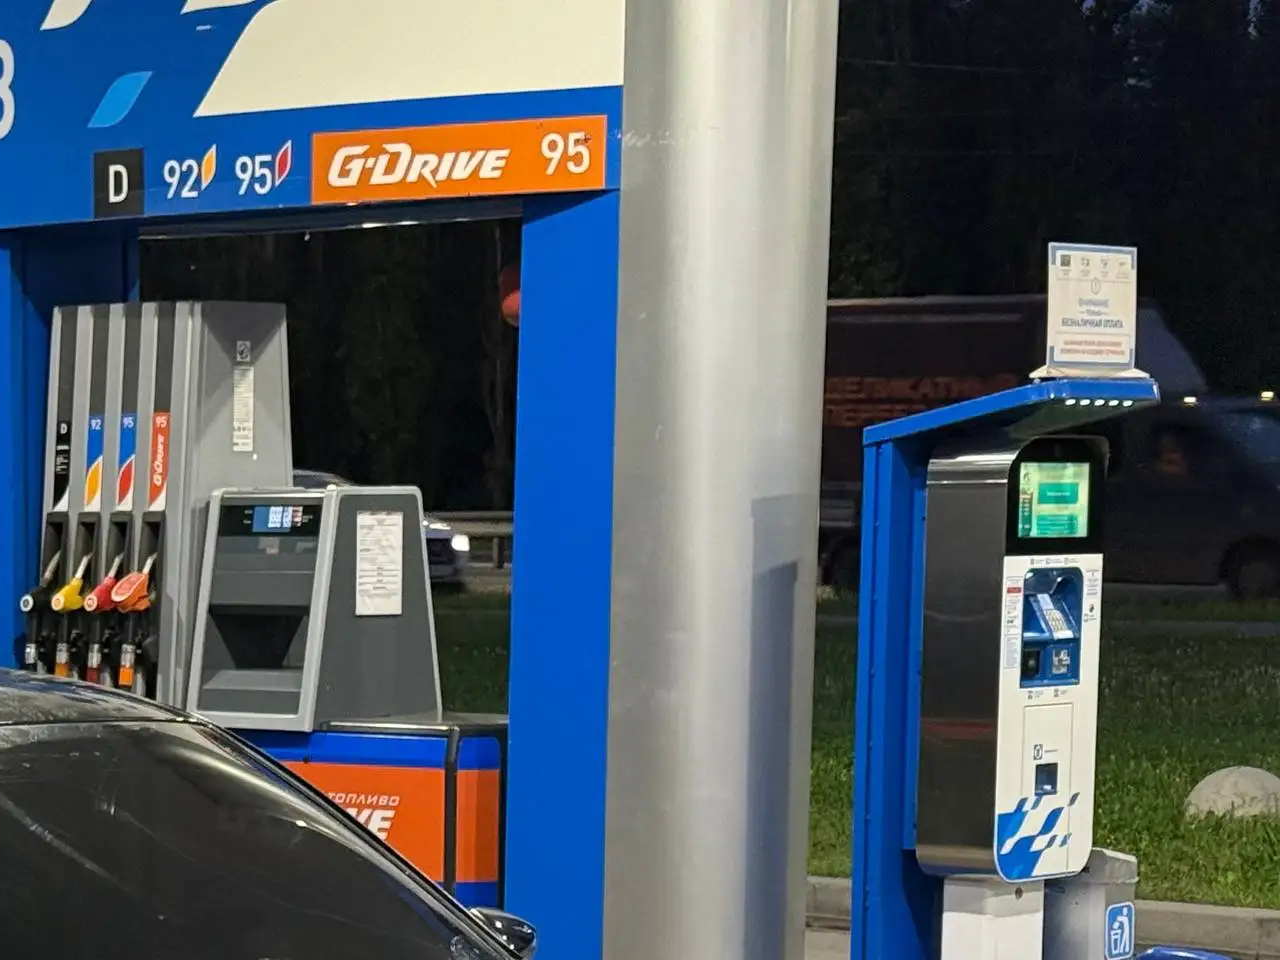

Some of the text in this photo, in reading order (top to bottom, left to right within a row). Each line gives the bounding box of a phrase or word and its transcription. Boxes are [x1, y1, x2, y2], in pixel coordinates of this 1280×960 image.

[108, 163, 129, 203] D
[163, 159, 200, 199] 92
[235, 154, 272, 196] 95
[539, 132, 591, 176] 95
[91, 418, 102, 431] 92
[123, 416, 134, 429] 95
[156, 415, 167, 429] 95
